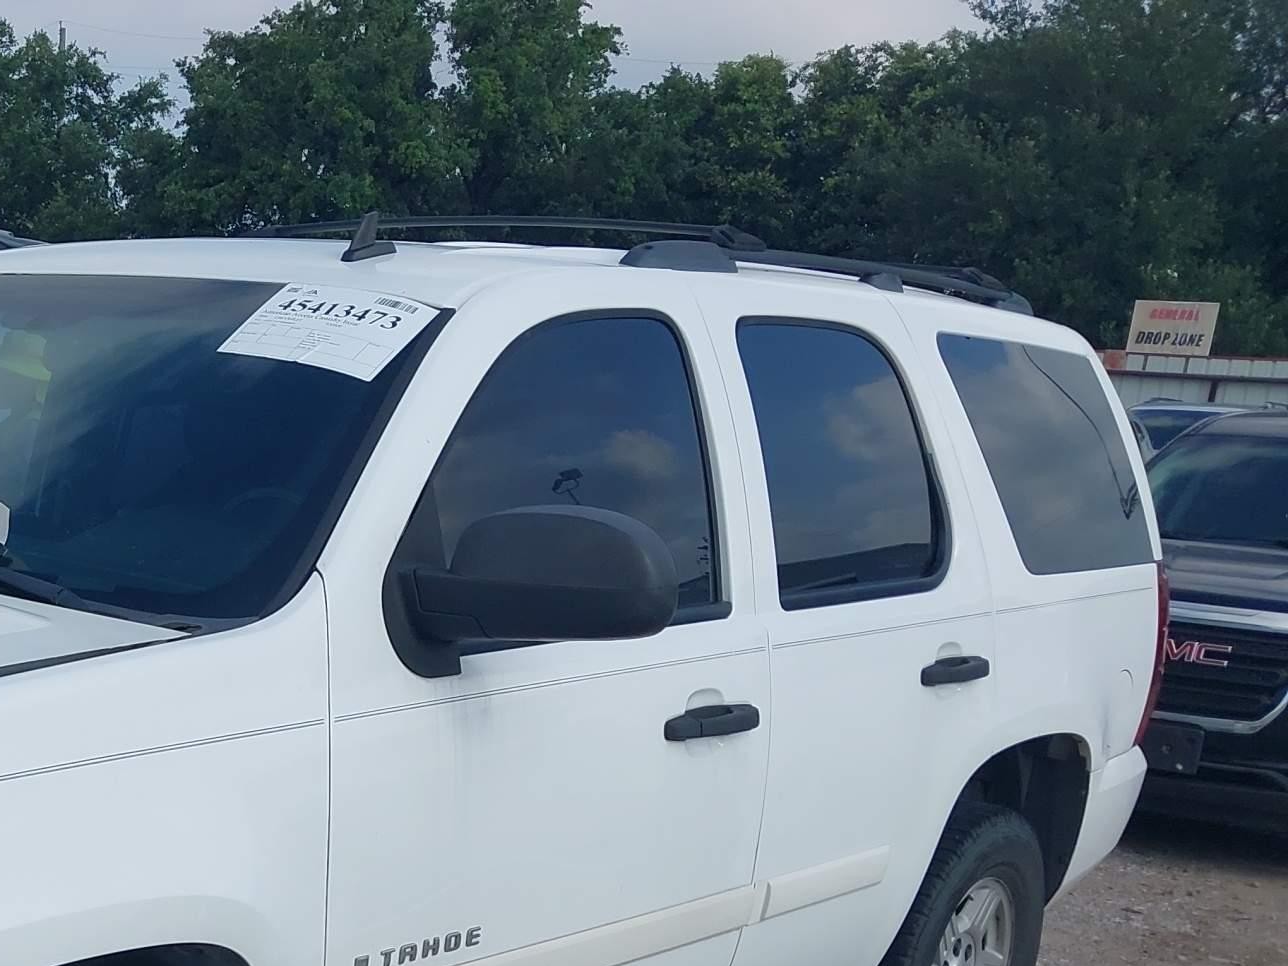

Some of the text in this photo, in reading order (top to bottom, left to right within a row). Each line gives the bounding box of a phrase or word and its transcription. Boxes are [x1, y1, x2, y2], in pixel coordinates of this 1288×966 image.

[278, 298, 402, 330] 45413473
[1135, 331, 1205, 347] DROP ZONE
[1166, 639, 1232, 667] MC
